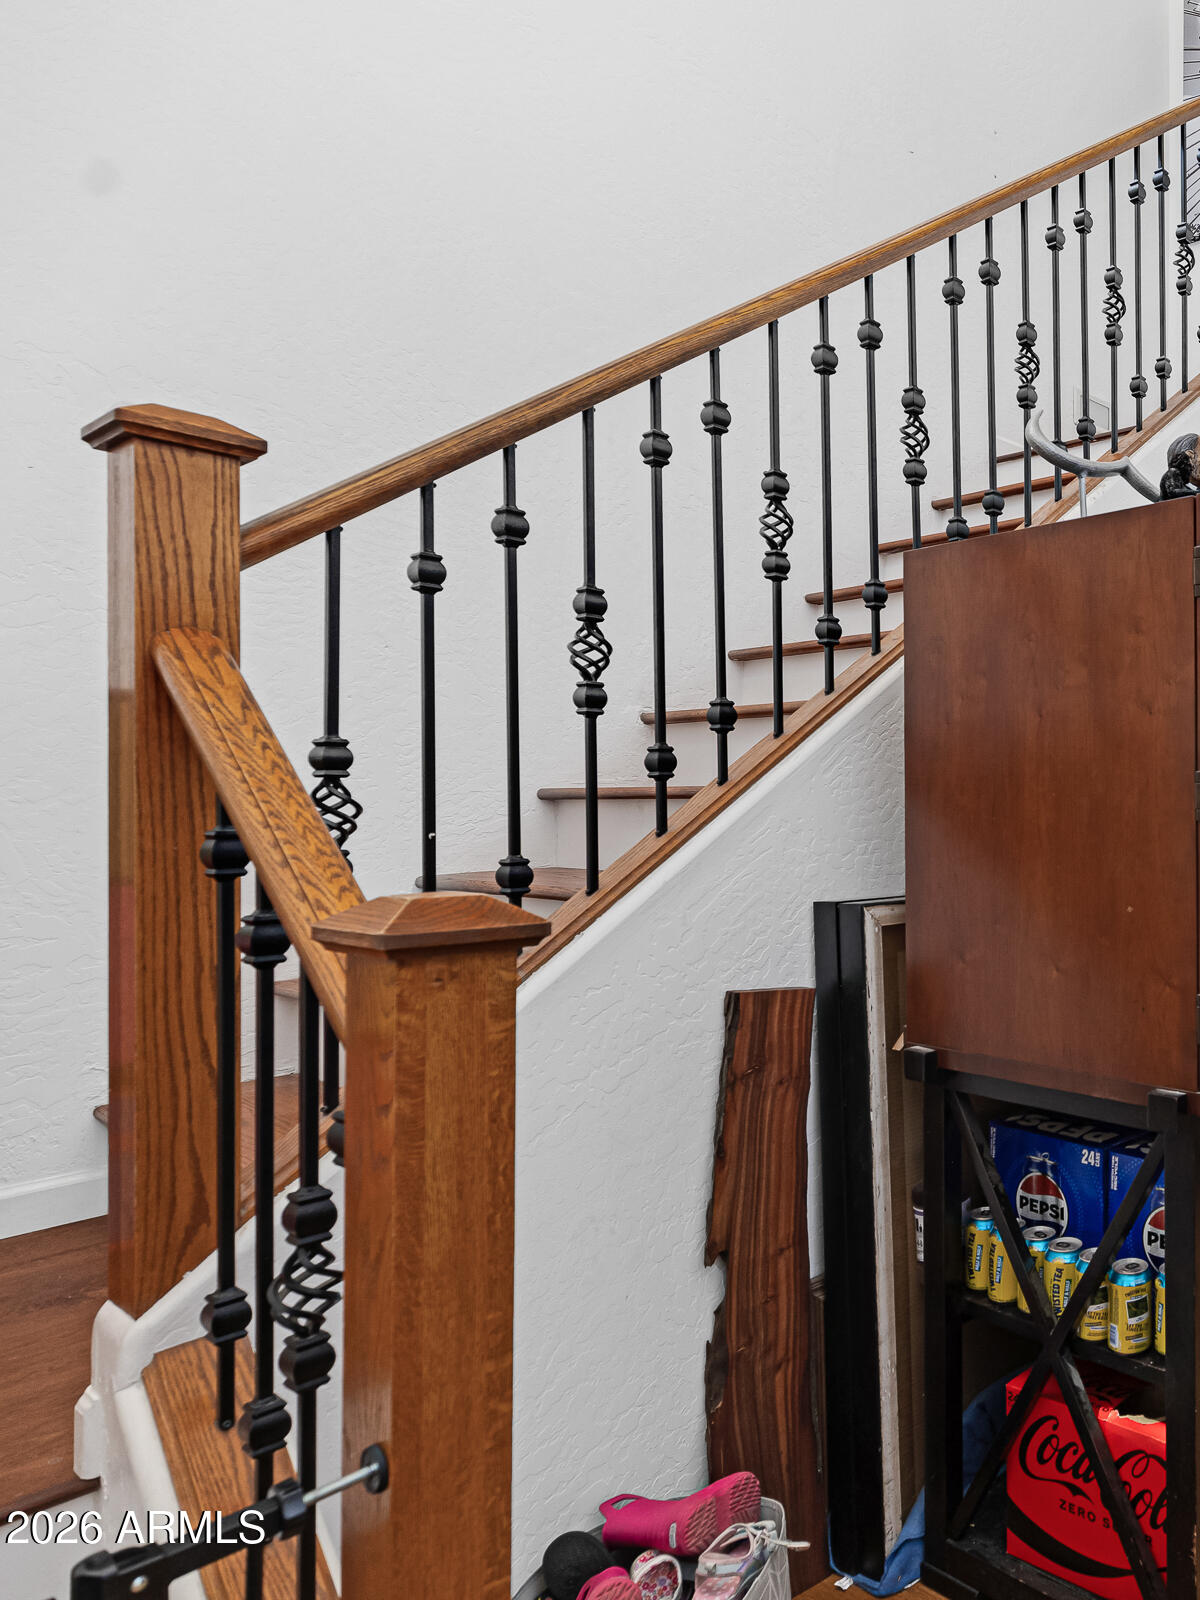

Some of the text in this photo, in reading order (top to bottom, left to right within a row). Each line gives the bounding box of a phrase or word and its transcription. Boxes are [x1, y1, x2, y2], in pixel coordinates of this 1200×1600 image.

[1081, 1149, 1094, 1167] 24
[1019, 1195, 1065, 1220] PEPSI
[1059, 1500, 1097, 1522] ZERO
